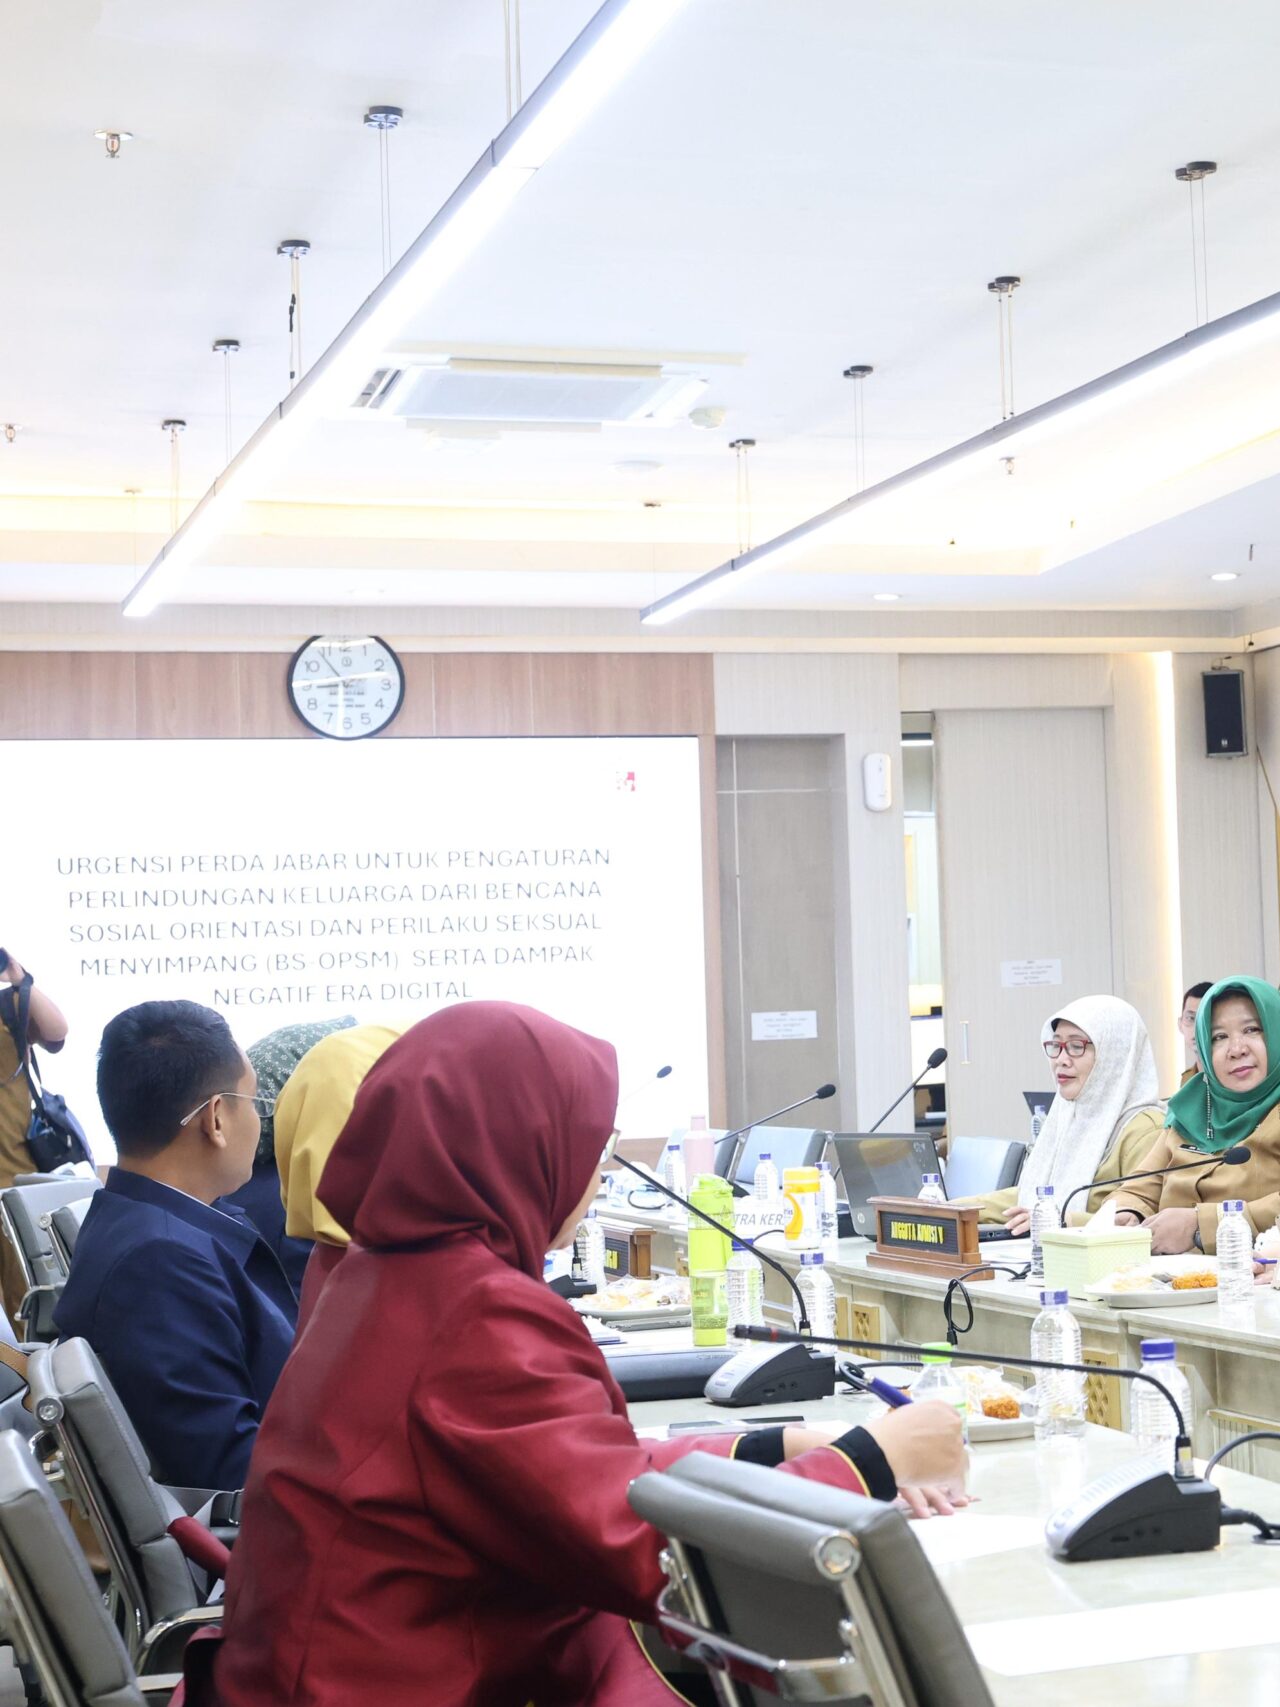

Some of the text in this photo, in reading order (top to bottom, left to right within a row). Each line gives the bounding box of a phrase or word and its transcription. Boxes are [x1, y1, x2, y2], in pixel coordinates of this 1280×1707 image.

[363, 645, 367, 656] 1
[305, 660, 320, 673] 10
[374, 659, 385, 672] 2
[381, 679, 392, 691] 3
[307, 697, 318, 710] 8
[374, 698, 385, 709] 4
[323, 712, 334, 724] 7
[343, 717, 353, 730] 6
[360, 712, 371, 725] 5
[58, 849, 609, 874] URGENSI PERDA JABAR UNTUK PENGATURAN
[69, 881, 601, 908] PERLINDUNGAN KELUARGA DARI BENCANA
[70, 914, 600, 942] SOSIAL ORIENTASI DAN PERILAKU SEKSUAL
[81, 946, 592, 976] MENYIMPANG (BS-OPSM) SERTA DAMPAK
[214, 981, 472, 1005] NEGATIF ERA DIGITAL
[733, 1213, 756, 1225] TRA
